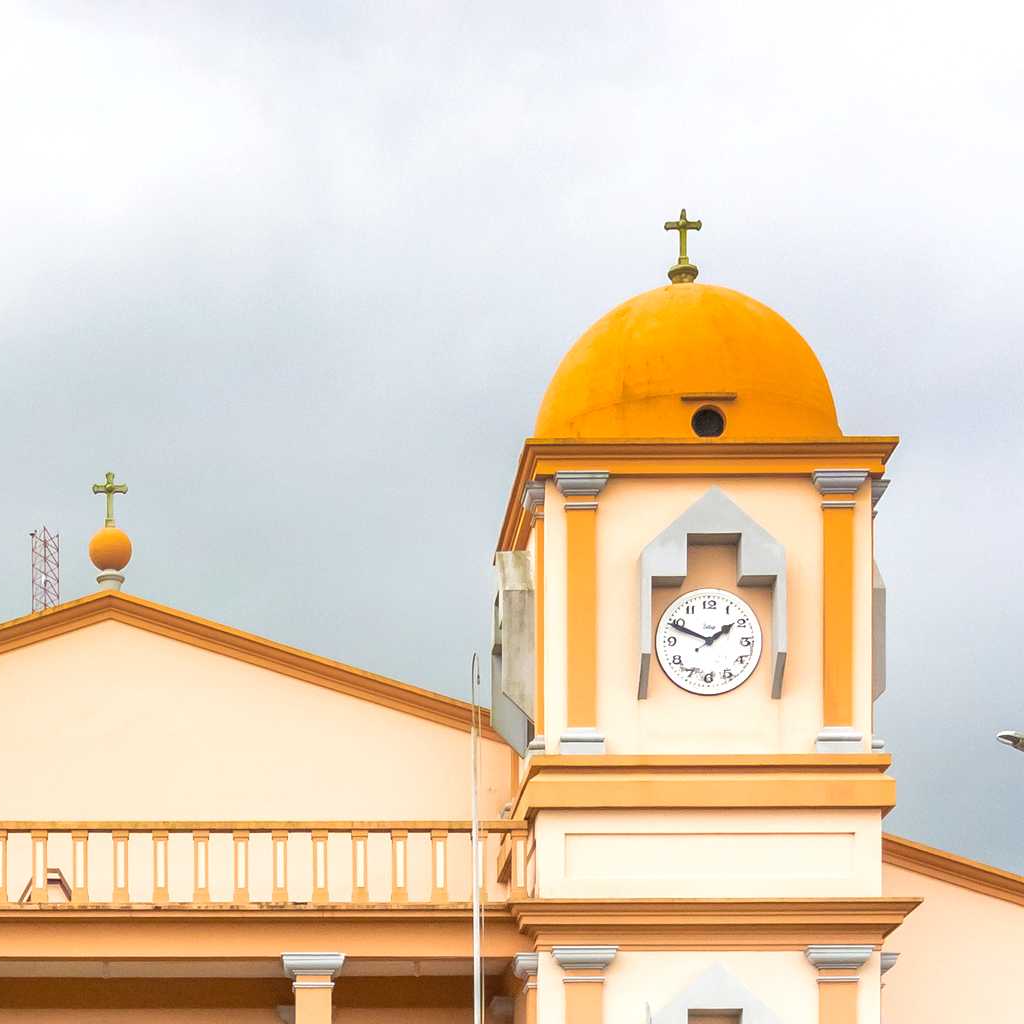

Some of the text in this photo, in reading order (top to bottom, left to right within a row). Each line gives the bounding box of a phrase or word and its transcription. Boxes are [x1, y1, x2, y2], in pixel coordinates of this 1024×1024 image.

[703, 600, 716, 609] 12
[686, 606, 694, 614] 11
[726, 606, 730, 614] 1
[737, 618, 746, 628] 2
[667, 636, 676, 646] 9
[740, 637, 751, 647] 3
[672, 655, 681, 665] 8
[736, 655, 747, 664] 4
[685, 668, 694, 677] 7
[704, 671, 713, 683] 6
[723, 669, 733, 679] 5
